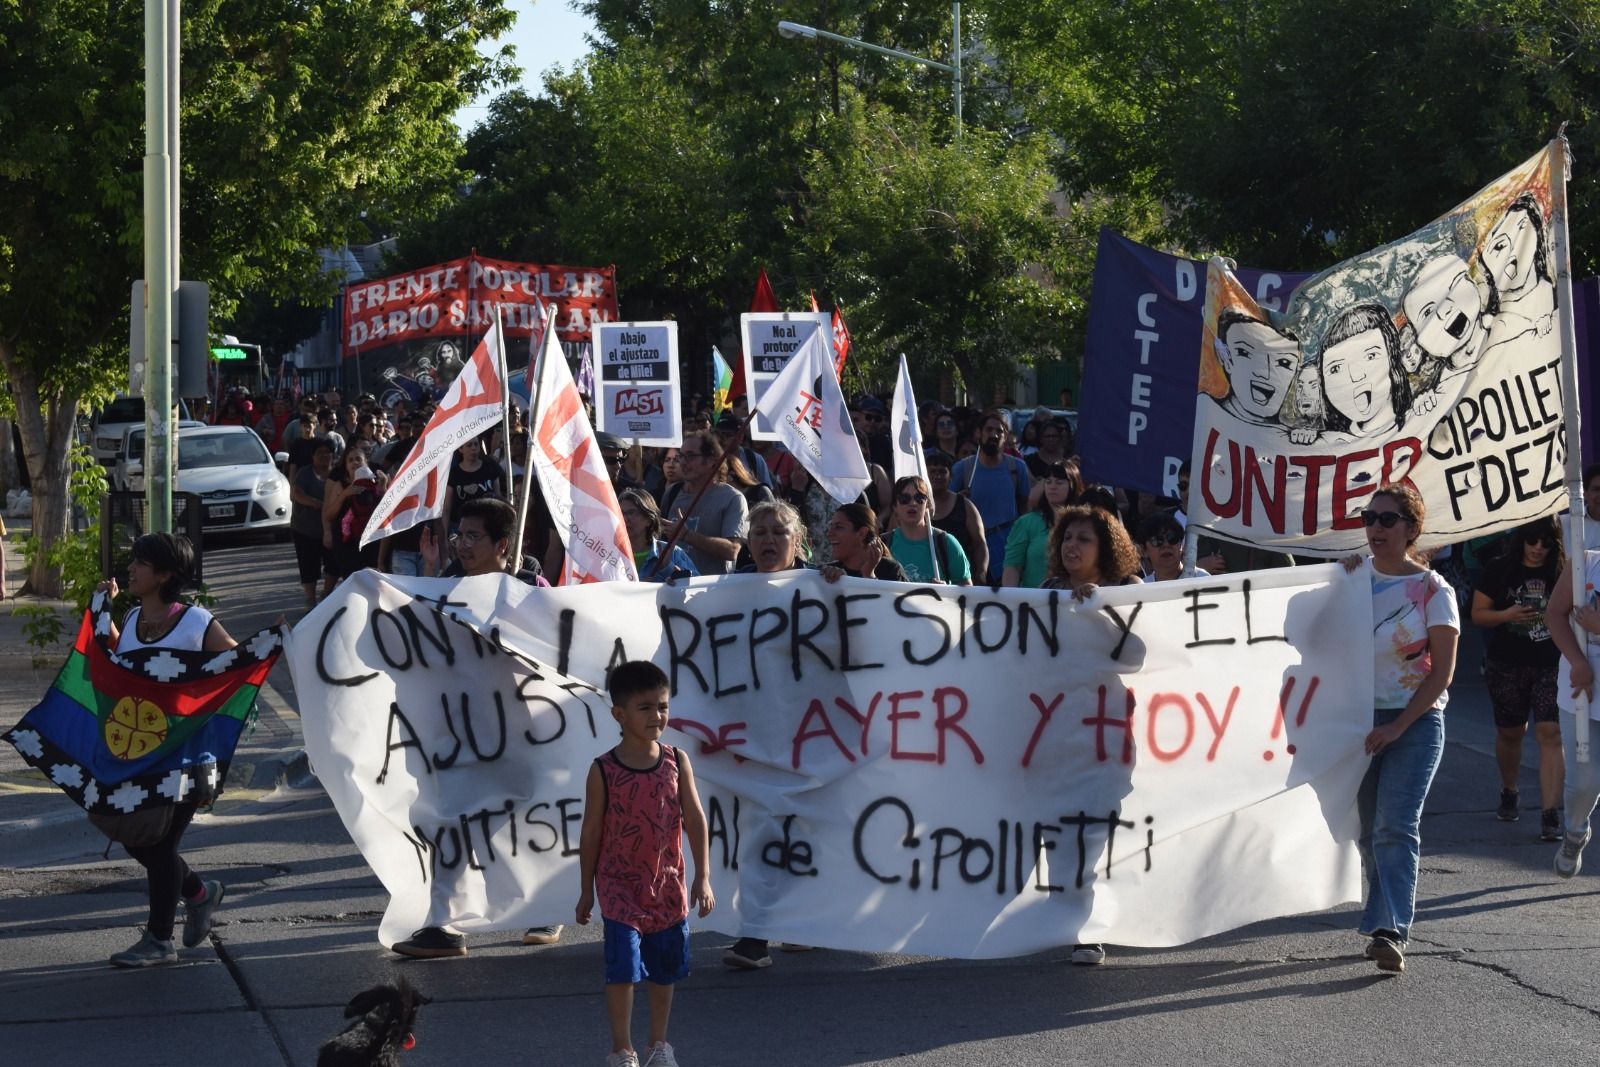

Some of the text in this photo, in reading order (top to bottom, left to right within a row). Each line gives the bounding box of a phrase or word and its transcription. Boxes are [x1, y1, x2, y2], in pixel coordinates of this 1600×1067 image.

[350, 260, 604, 313] FRENTE POPULAR
[349, 303, 440, 347] DARIO
[620, 332, 647, 346] Abajo
[772, 324, 797, 338] No al
[608, 348, 618, 361] el
[620, 348, 660, 363] ajustazo
[617, 363, 653, 379] de Milei
[762, 357, 775, 371] de
[1128, 293, 1159, 445] CTEP
[618, 391, 662, 415] MST
[1201, 427, 1423, 536] UNTER
[661, 587, 1059, 699] REPRESION
[1103, 600, 1143, 662] Y
[1183, 578, 1289, 649] EL
[375, 673, 606, 786] AJUST
[791, 686, 985, 769] AYER
[1020, 692, 1065, 768] Y
[1082, 685, 1241, 764] HOY
[761, 813, 819, 878] de
